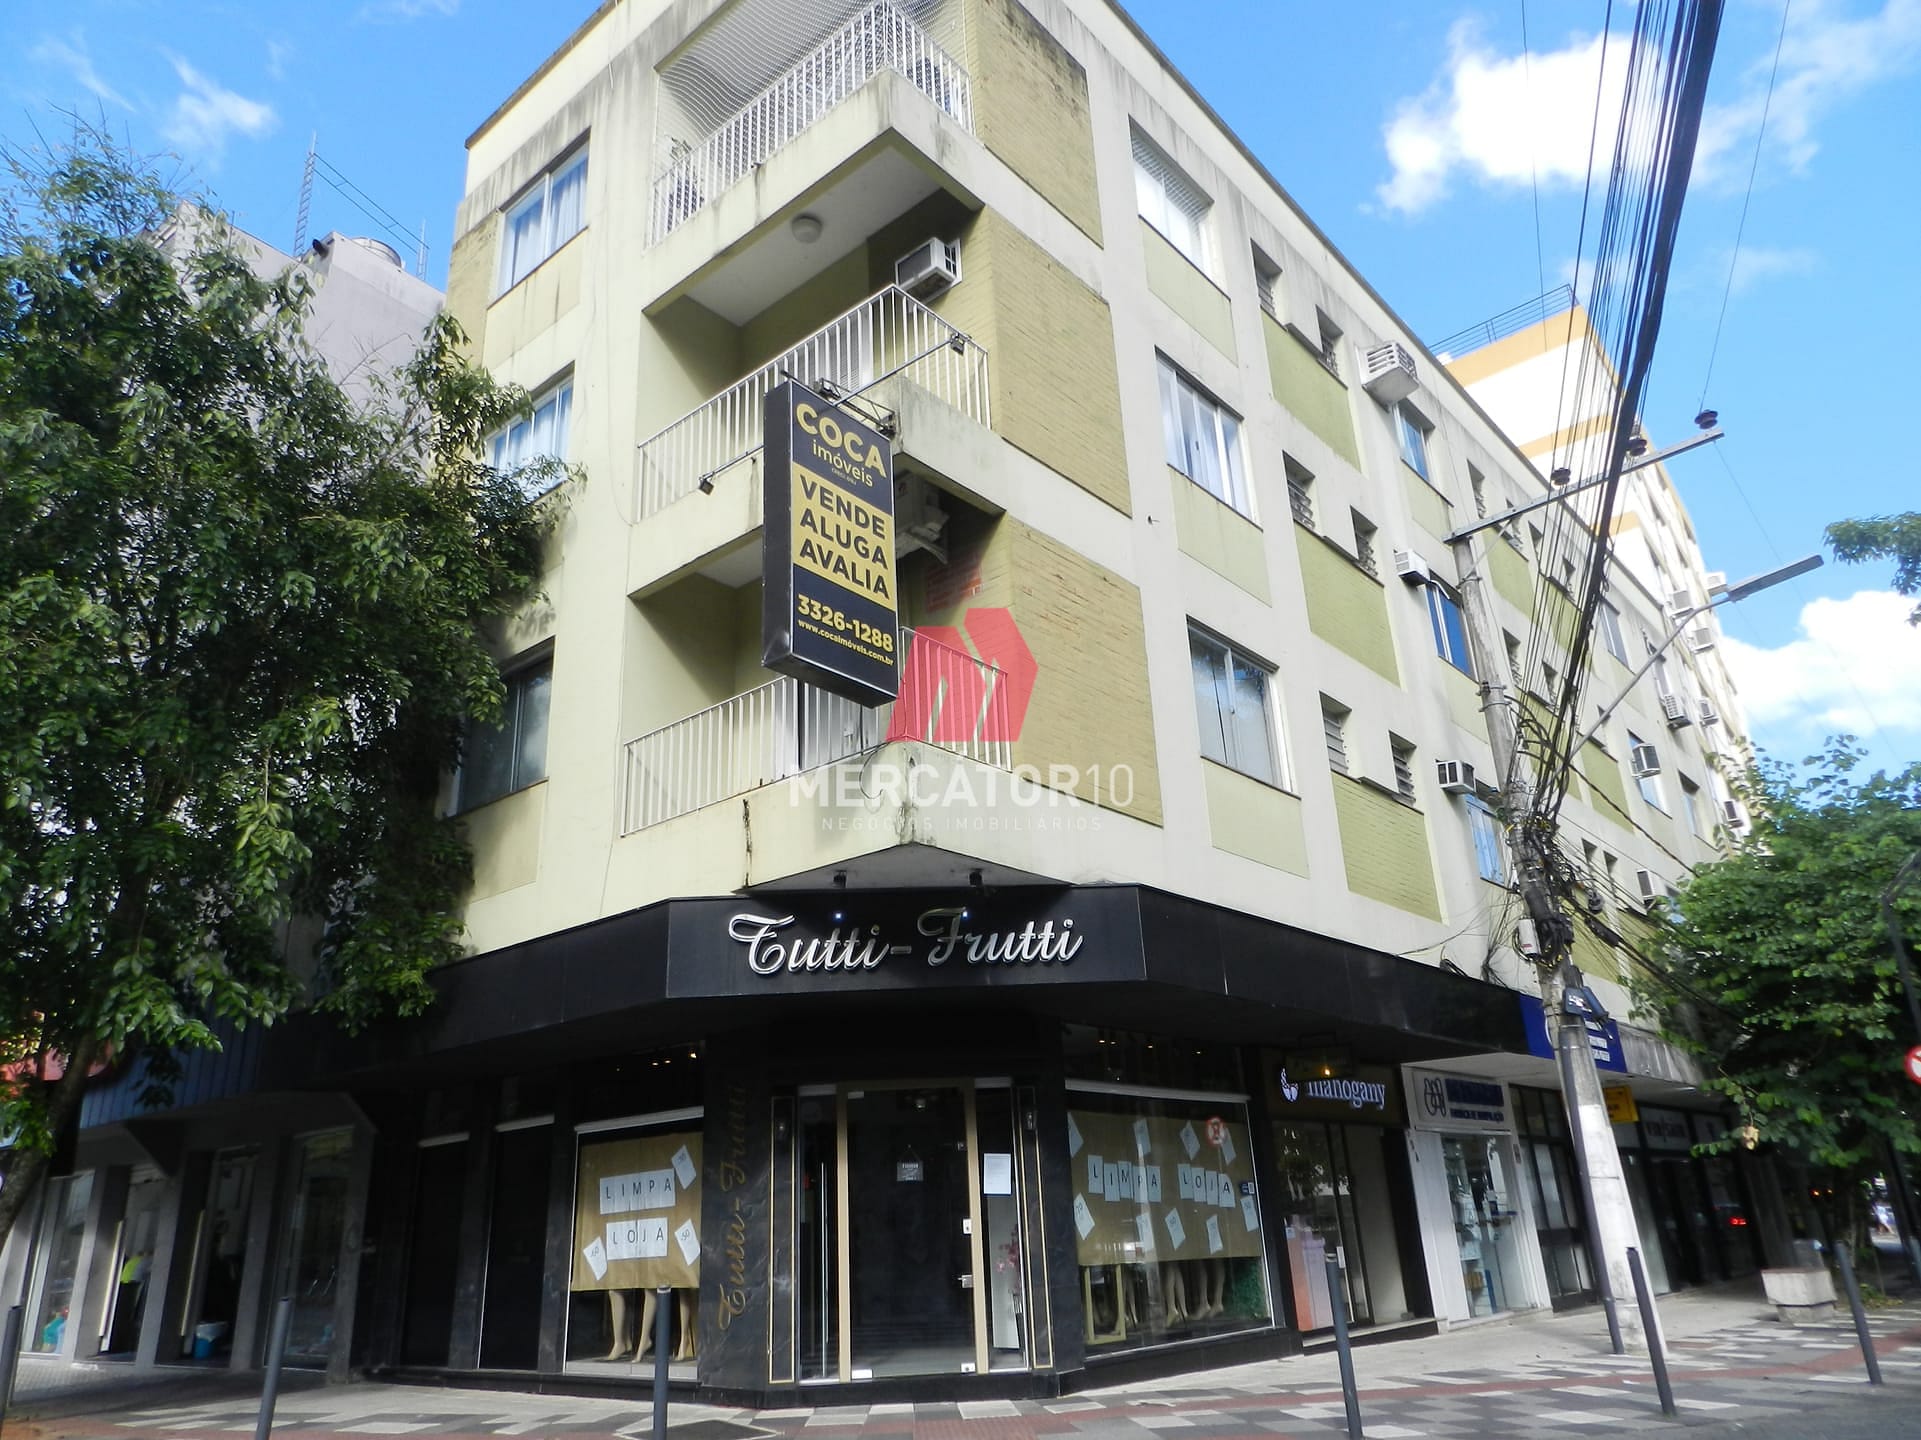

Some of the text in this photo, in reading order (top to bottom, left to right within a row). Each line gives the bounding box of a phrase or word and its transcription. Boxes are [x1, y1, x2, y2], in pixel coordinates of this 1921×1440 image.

[796, 403, 887, 478] COCA
[812, 439, 873, 488] imóveis
[800, 474, 886, 540] VENDE
[800, 507, 888, 570] ALUGA
[800, 538, 890, 600] AVALIA
[798, 593, 894, 653] 3326-1288
[605, 1177, 672, 1200] LIMPA
[1092, 1169, 1159, 1189] LIMPA
[612, 1226, 665, 1247] LOJA
